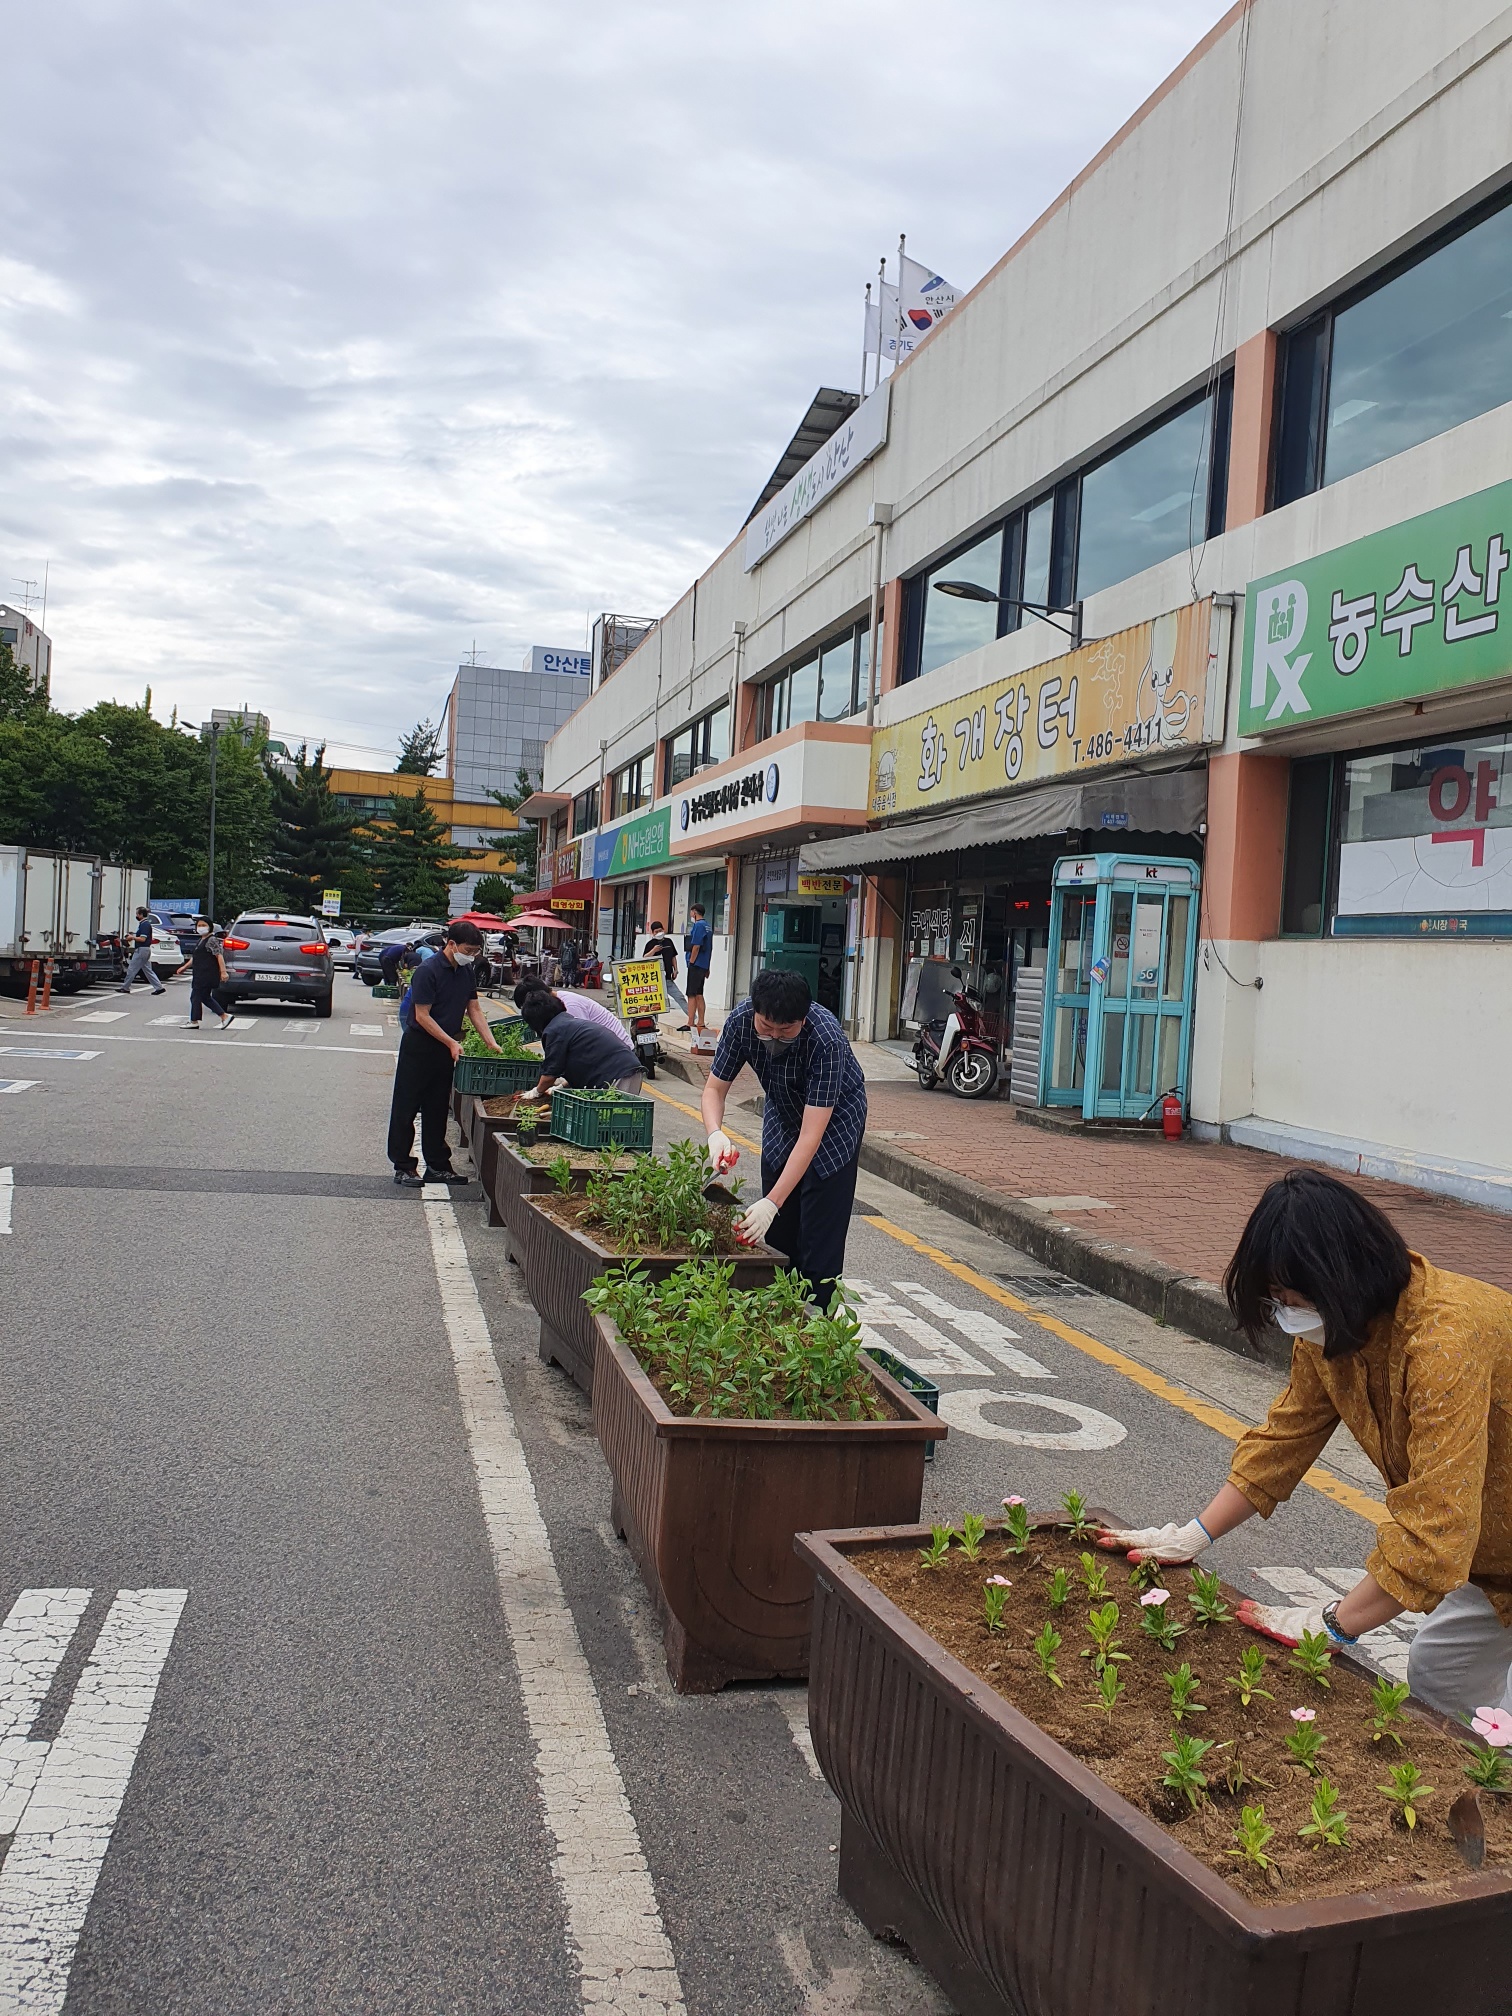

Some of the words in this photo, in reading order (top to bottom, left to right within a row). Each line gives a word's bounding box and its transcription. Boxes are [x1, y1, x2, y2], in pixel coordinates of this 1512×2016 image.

[925, 294, 954, 305] 안산시
[1328, 533, 1511, 676] 농수산
[917, 676, 1079, 792] 화개장터
[1428, 759, 1499, 868] 약
[1075, 862, 1084, 876] kt
[1145, 866, 1158, 879] kt
[801, 879, 843, 891] 백반전문
[911, 908, 952, 940] 구내식당
[621, 971, 659, 986] 화개장터
[1140, 969, 1154, 980] 5G
[623, 993, 663, 1005] 486-4411
